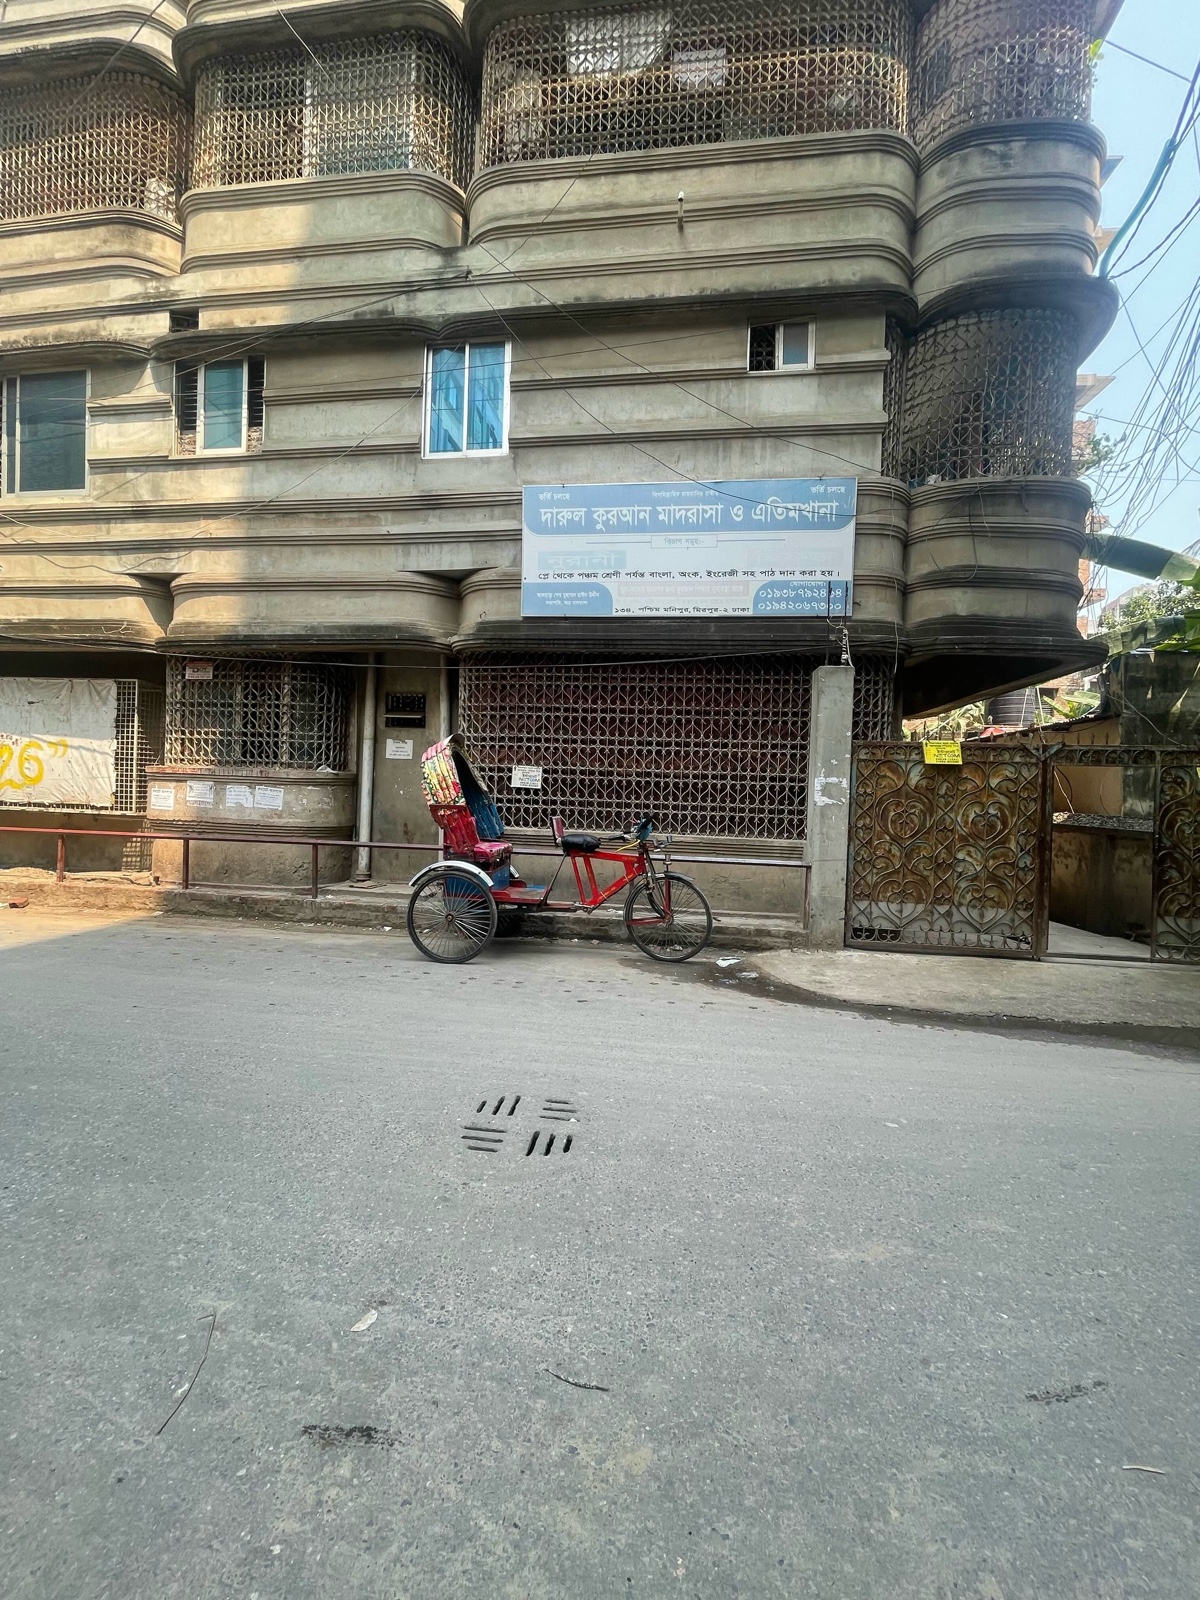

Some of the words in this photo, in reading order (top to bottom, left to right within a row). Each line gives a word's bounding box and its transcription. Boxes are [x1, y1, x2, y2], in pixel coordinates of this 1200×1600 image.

[811, 484, 825, 494] ভর্তি
[828, 485, 846, 494] চলছে
[538, 491, 551, 501] ভর্তি
[553, 493, 571, 501] চলছে
[539, 506, 588, 528] দারুল
[591, 504, 653, 533] কুরআন
[656, 502, 724, 526] মাদরাসা
[730, 504, 744, 522] ও
[752, 496, 839, 523] এতিমখানা
[552, 571, 575, 580] থেকে
[577, 571, 599, 579] পঞ্চম
[625, 570, 645, 579] পর্যন্ত
[649, 571, 675, 580] বাংলা,
[678, 570, 703, 580] অংক,
[706, 568, 738, 578] ইংরেজী
[742, 570, 756, 578] সহ
[759, 568, 776, 577] পাঠ
[779, 569, 796, 577] দান
[799, 569, 816, 577] করা
[638, 605, 660, 613] পশ্চিম
[732, 606, 750, 614] ঢাকা
